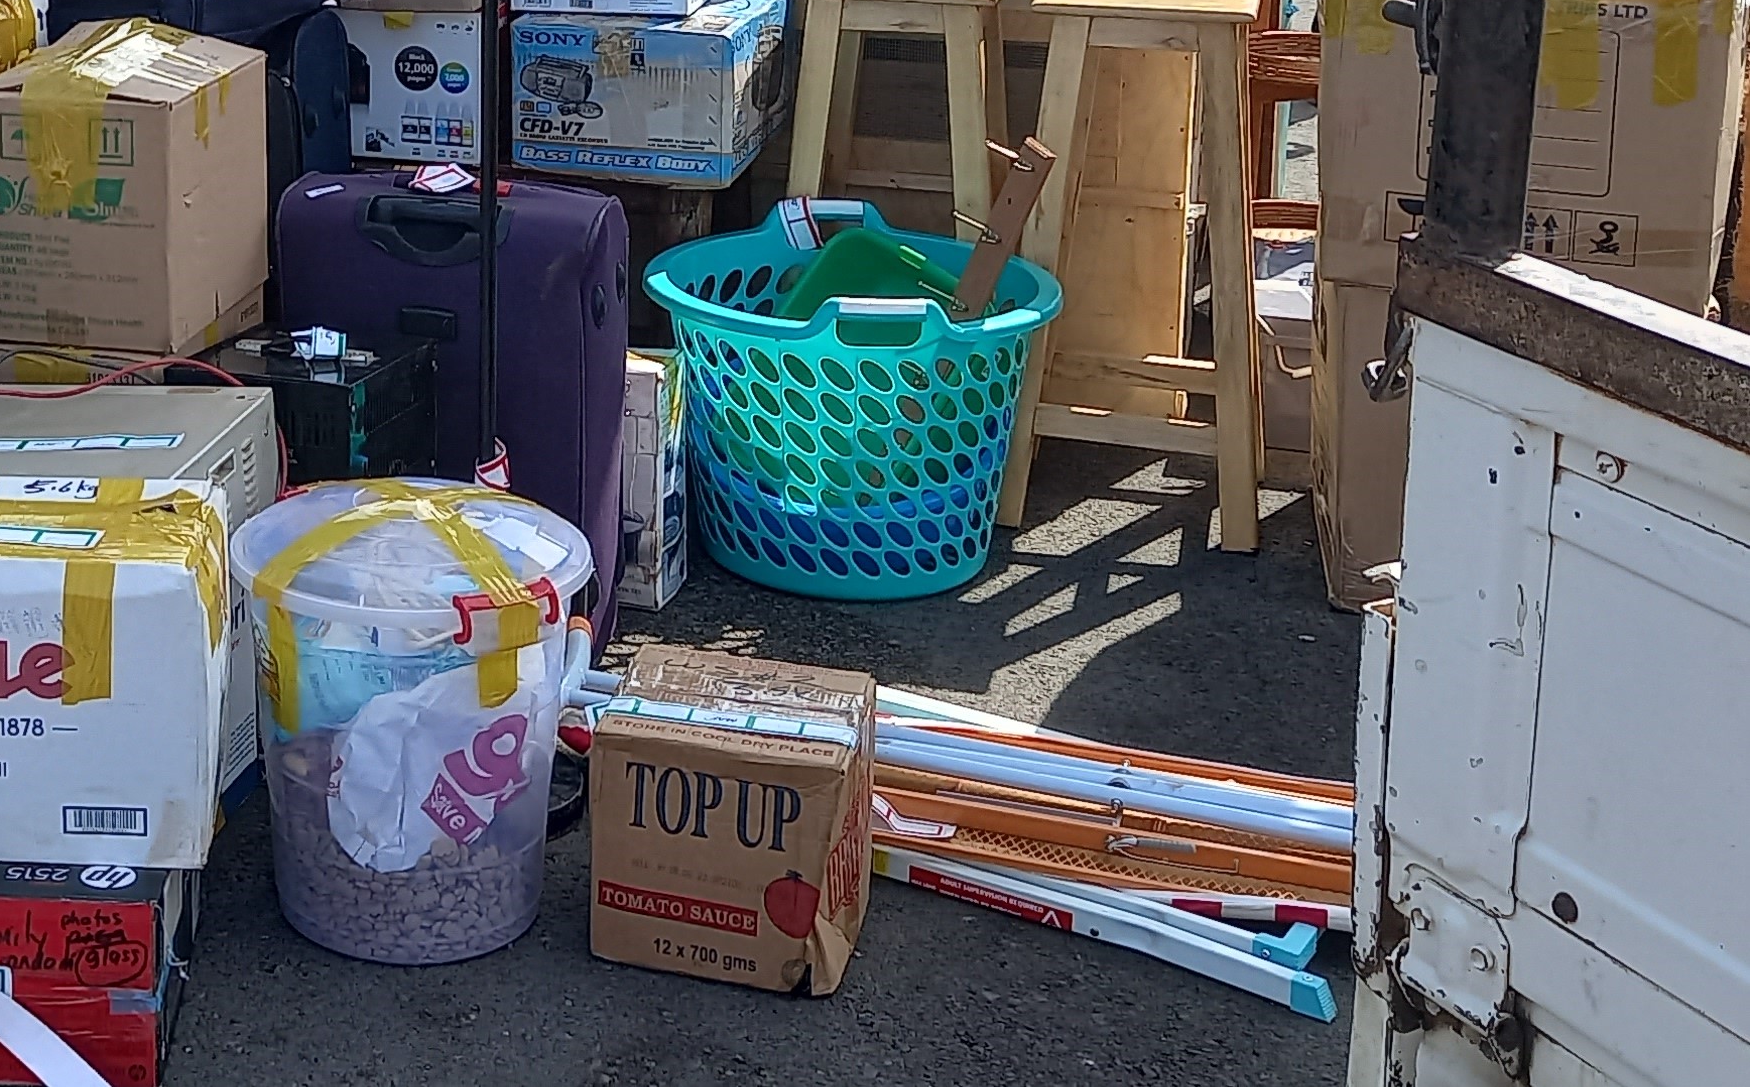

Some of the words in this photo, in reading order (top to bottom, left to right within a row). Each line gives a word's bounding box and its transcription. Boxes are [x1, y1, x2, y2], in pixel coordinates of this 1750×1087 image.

[1613, 3, 1648, 19] LTD
[518, 31, 586, 46] SONY
[398, 62, 435, 75] 12,000
[519, 117, 586, 137] CFD-V7
[519, 145, 571, 164] BASS
[576, 148, 652, 169] REFLEX
[655, 155, 711, 172] BODY
[0, 718, 45, 737] 1878
[612, 719, 668, 734] STORE
[670, 726, 687, 735] IN
[690, 730, 736, 744] COOL
[741, 737, 775, 751] DRY
[778, 743, 835, 758] PLACE
[625, 761, 723, 840] TOP
[734, 777, 802, 852] UP
[5, 866, 70, 882] 2515
[601, 886, 685, 917] TOMATO
[690, 904, 756, 932] SAUCE
[653, 937, 671, 956] 12
[675, 944, 685, 958] x
[690, 943, 718, 964] 700
[722, 954, 757, 973] gms
